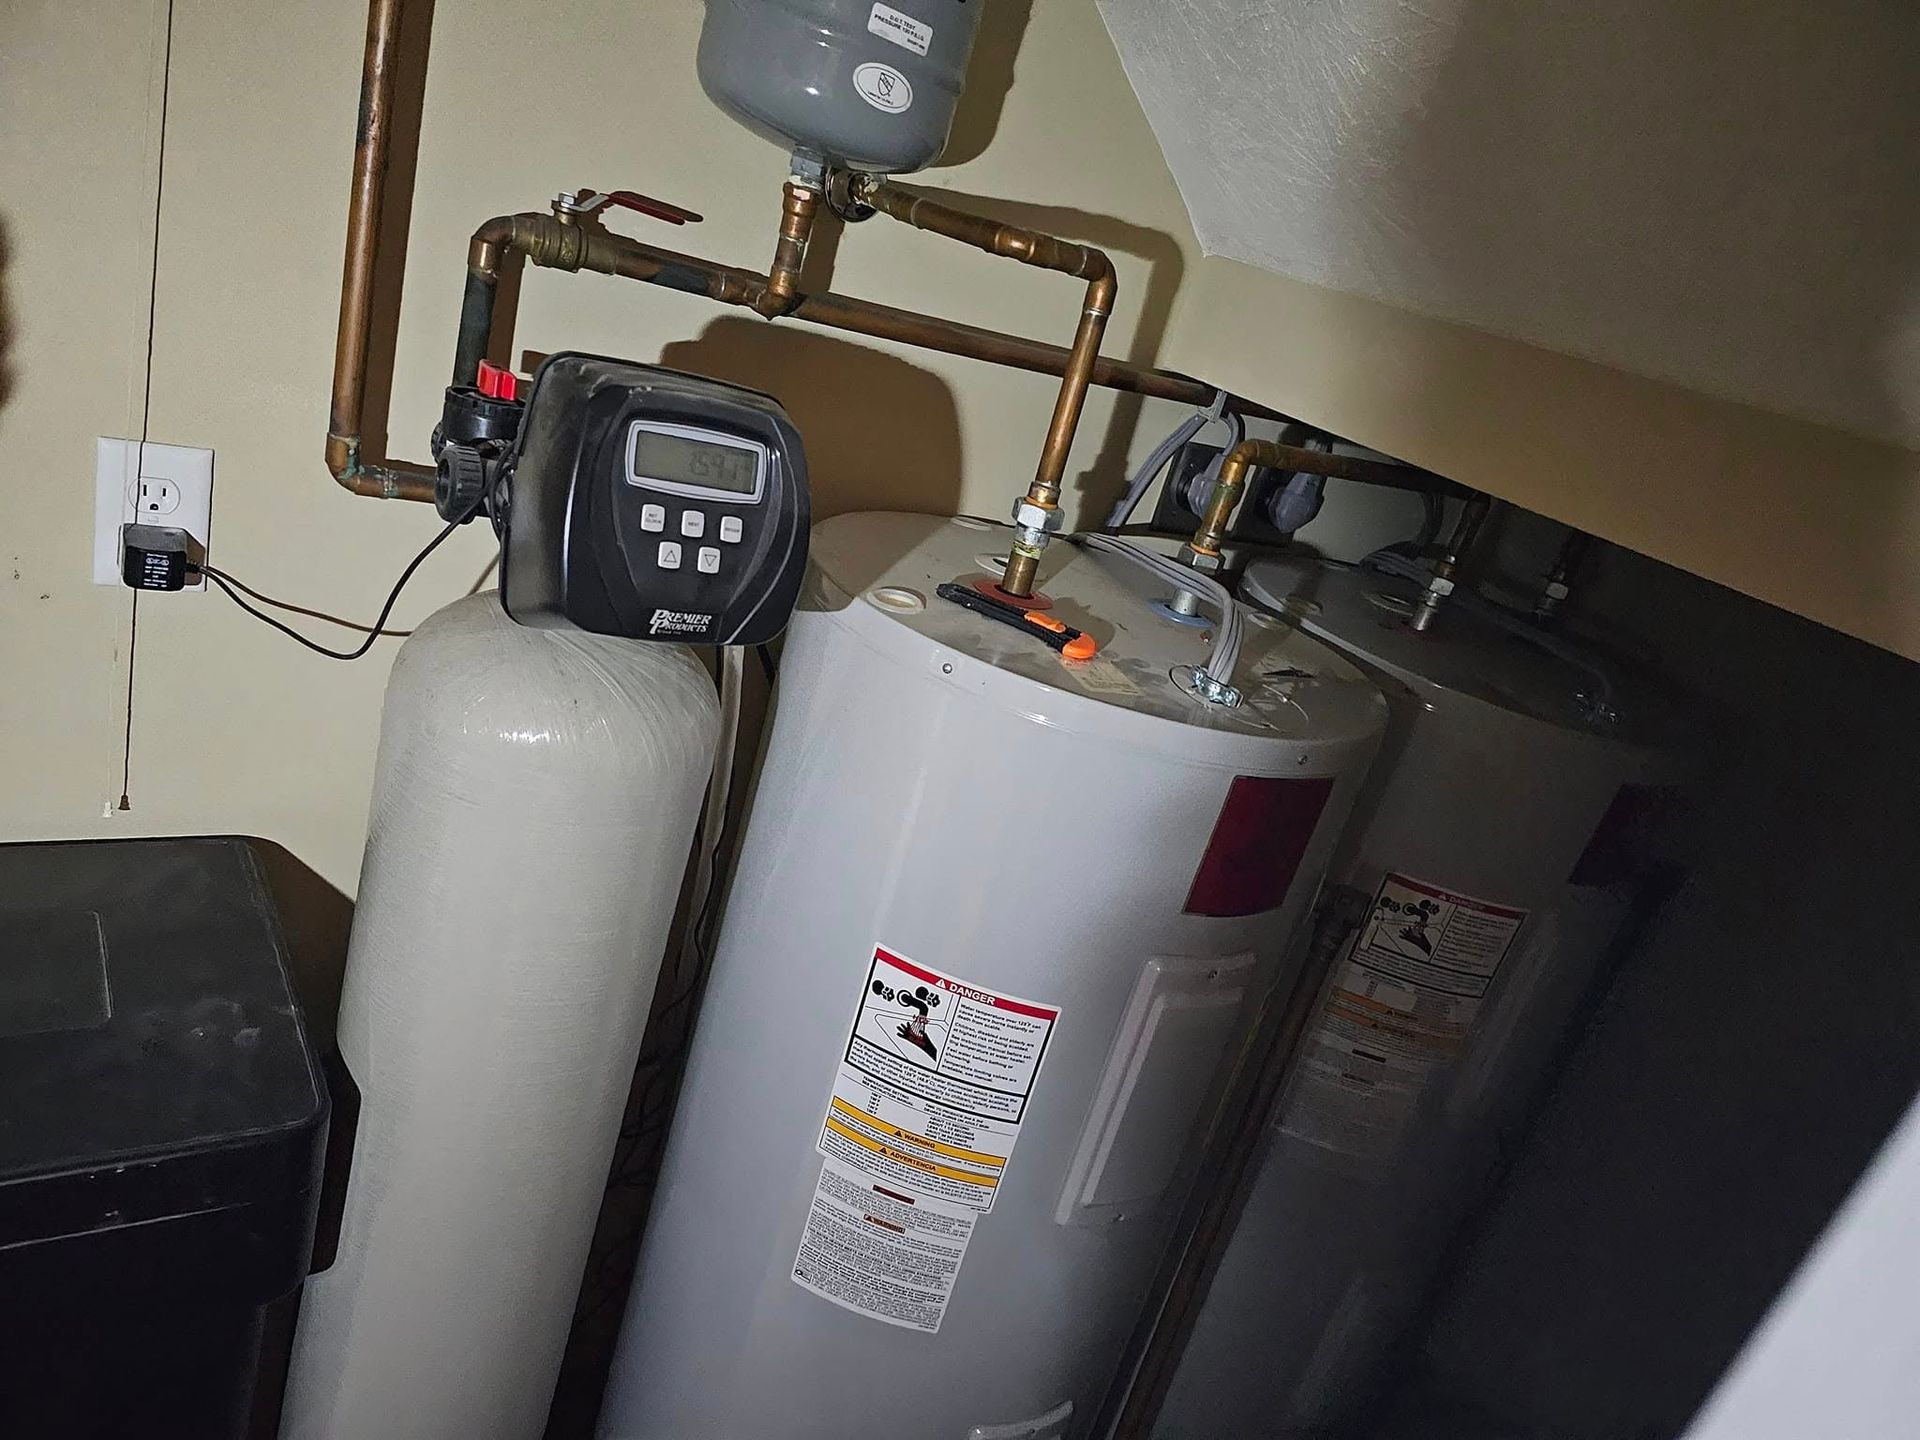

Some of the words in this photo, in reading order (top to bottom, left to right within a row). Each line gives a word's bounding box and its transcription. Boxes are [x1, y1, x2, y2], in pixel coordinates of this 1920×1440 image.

[874, 13, 902, 31] PRESSURE
[649, 609, 713, 626] PREMIER
[649, 619, 708, 635] PRODUCTS
[949, 983, 996, 1006] DANGER
[904, 1132, 936, 1149] WARNING
[889, 1150, 938, 1172] ADVERTENCIA
